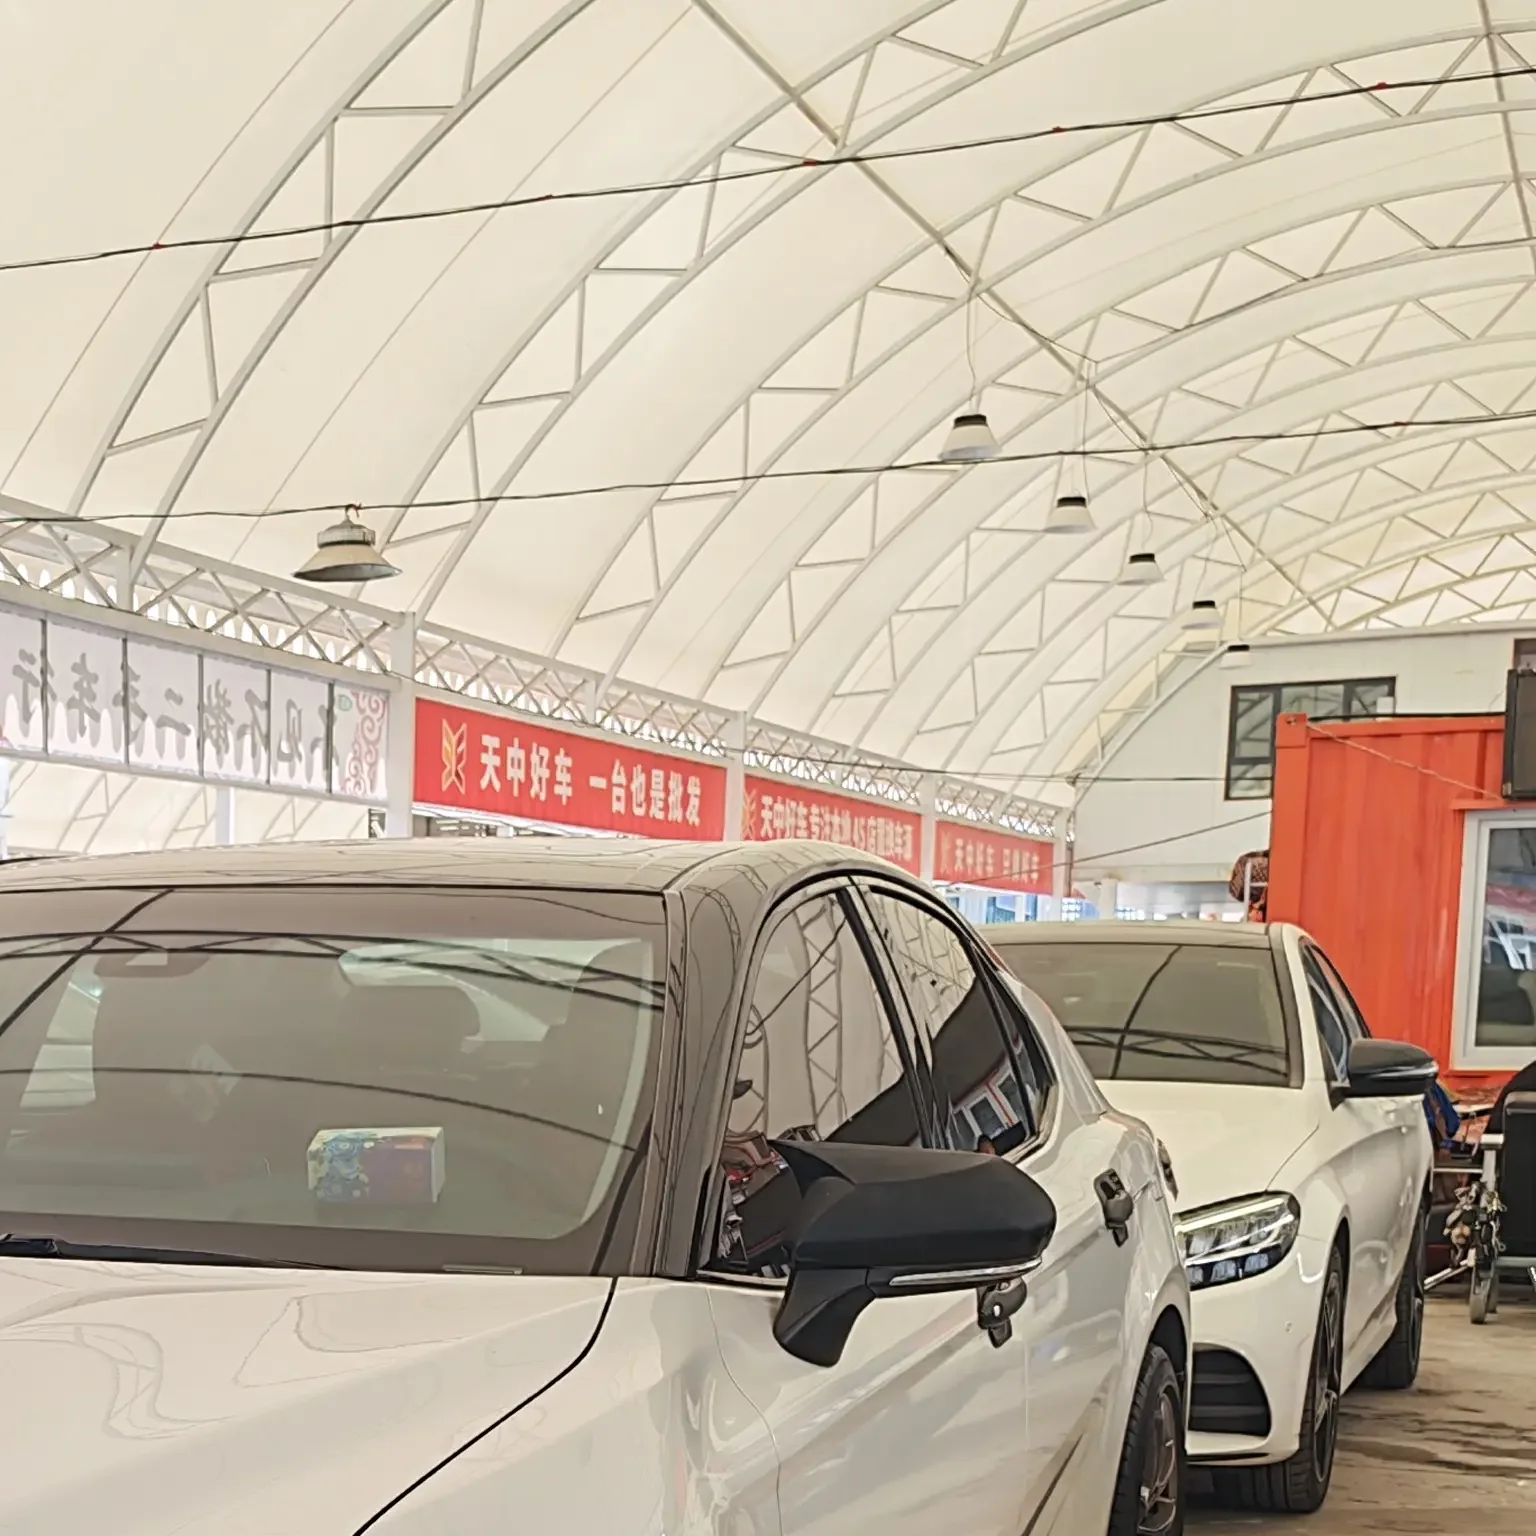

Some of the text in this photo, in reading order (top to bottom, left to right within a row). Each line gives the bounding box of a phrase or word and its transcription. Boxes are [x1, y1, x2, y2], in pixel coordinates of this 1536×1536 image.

[480, 734, 701, 827] 天中好车 一台也是批发
